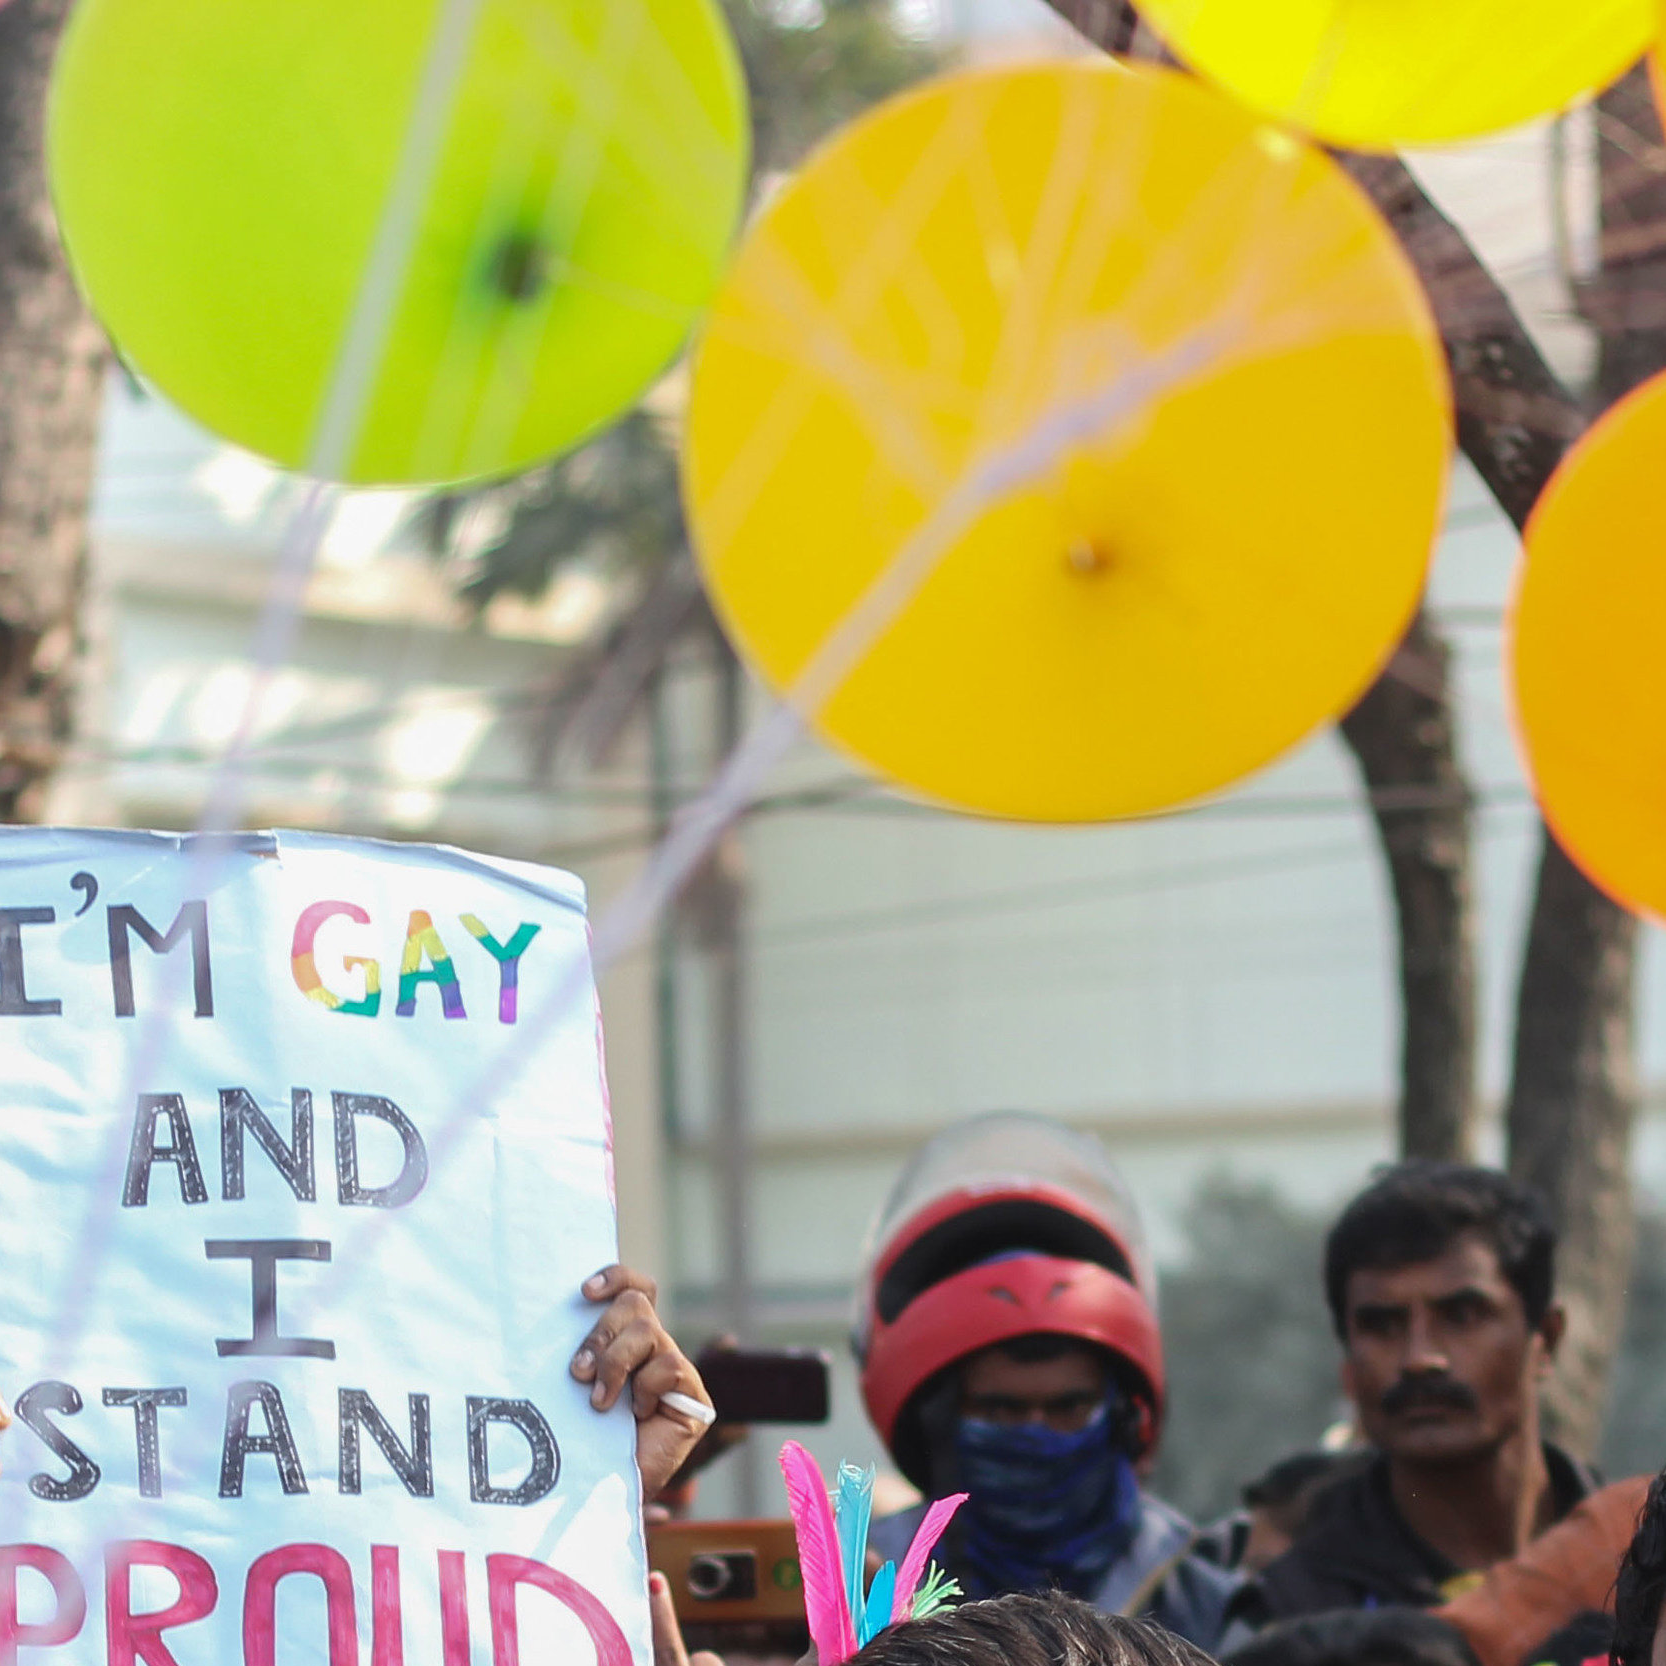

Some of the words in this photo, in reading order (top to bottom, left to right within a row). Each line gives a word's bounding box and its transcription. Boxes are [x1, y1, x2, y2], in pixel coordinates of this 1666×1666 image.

[290, 899, 542, 1026] GAY
[121, 1085, 429, 1209] AND
[204, 1237, 337, 1360] I
[14, 1379, 562, 1506] STAND
